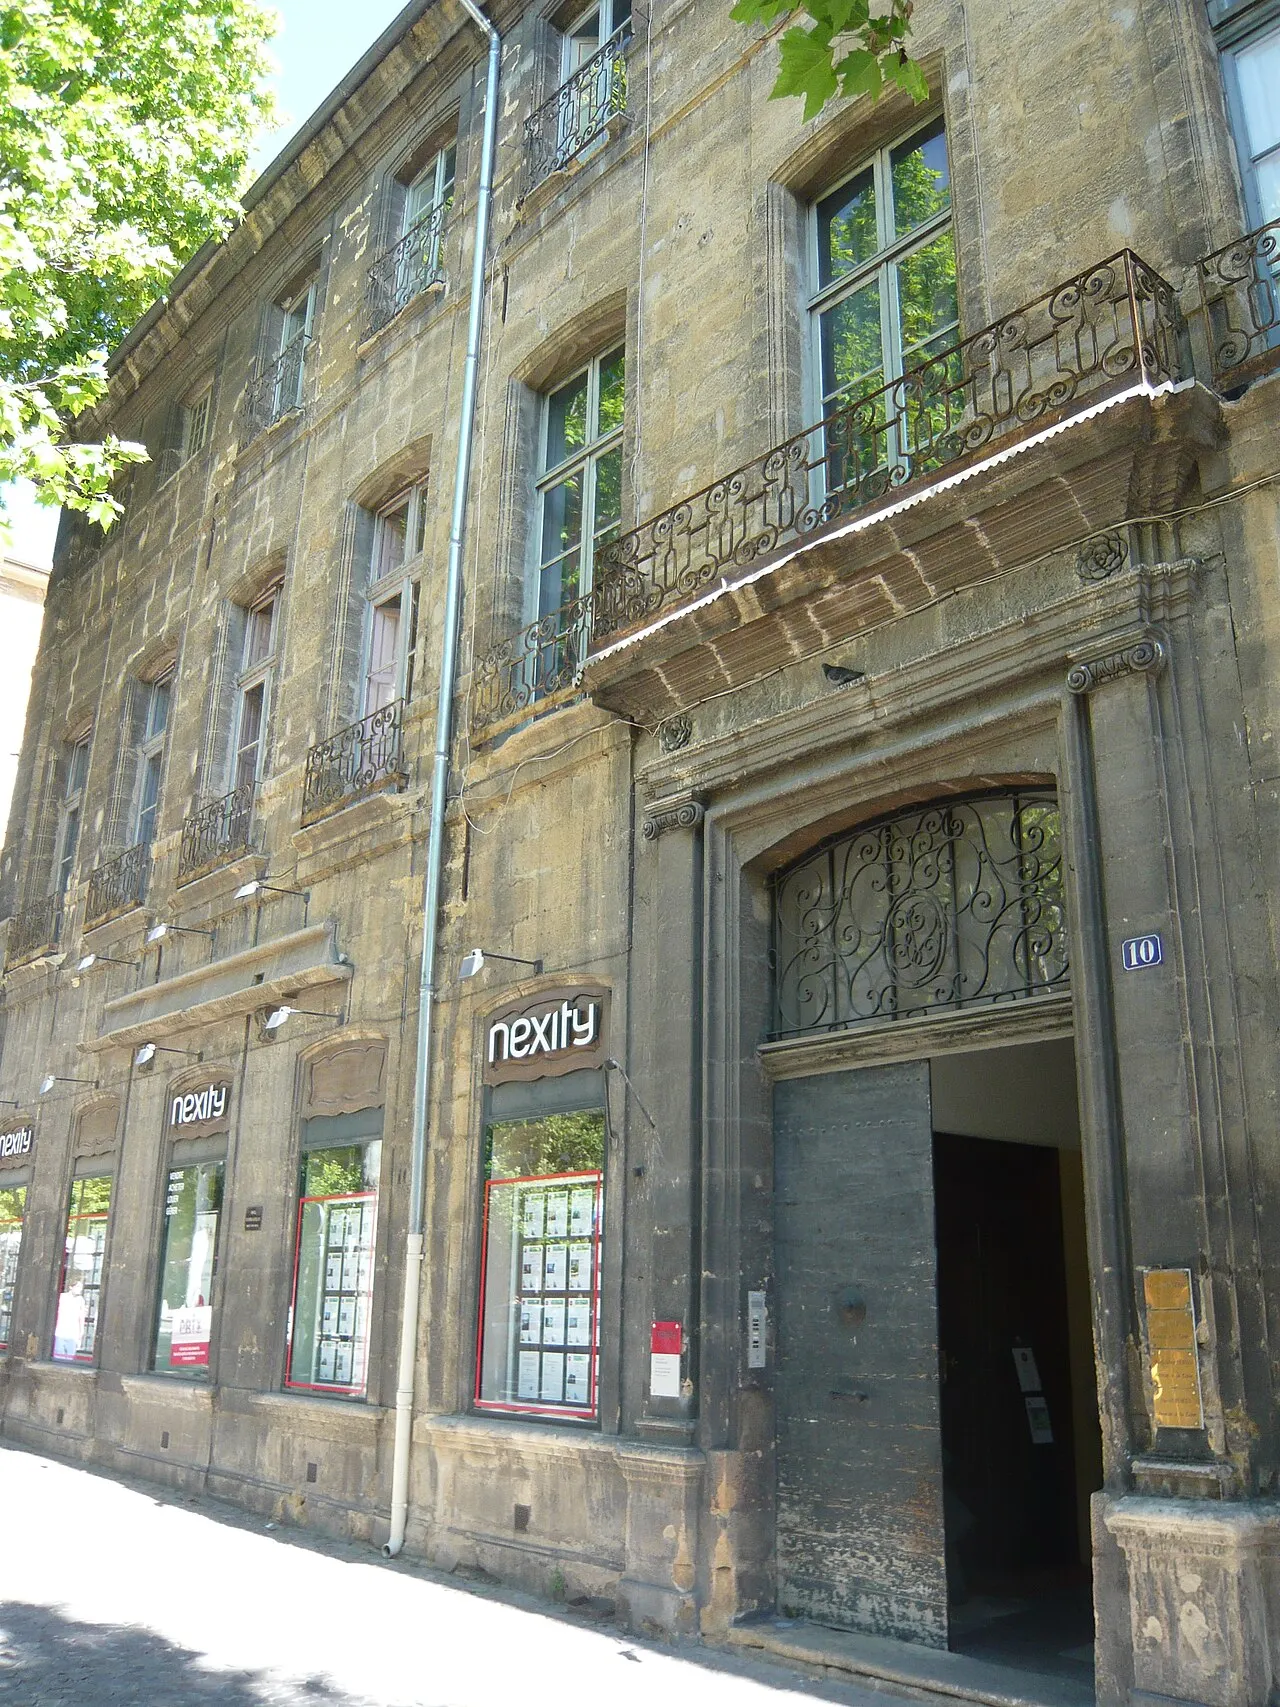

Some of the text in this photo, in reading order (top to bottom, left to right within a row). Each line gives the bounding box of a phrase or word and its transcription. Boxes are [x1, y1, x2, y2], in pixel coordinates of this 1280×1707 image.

[1129, 940, 1154, 966] 10
[489, 1001, 594, 1062] nexity
[171, 1085, 226, 1125] nexity
